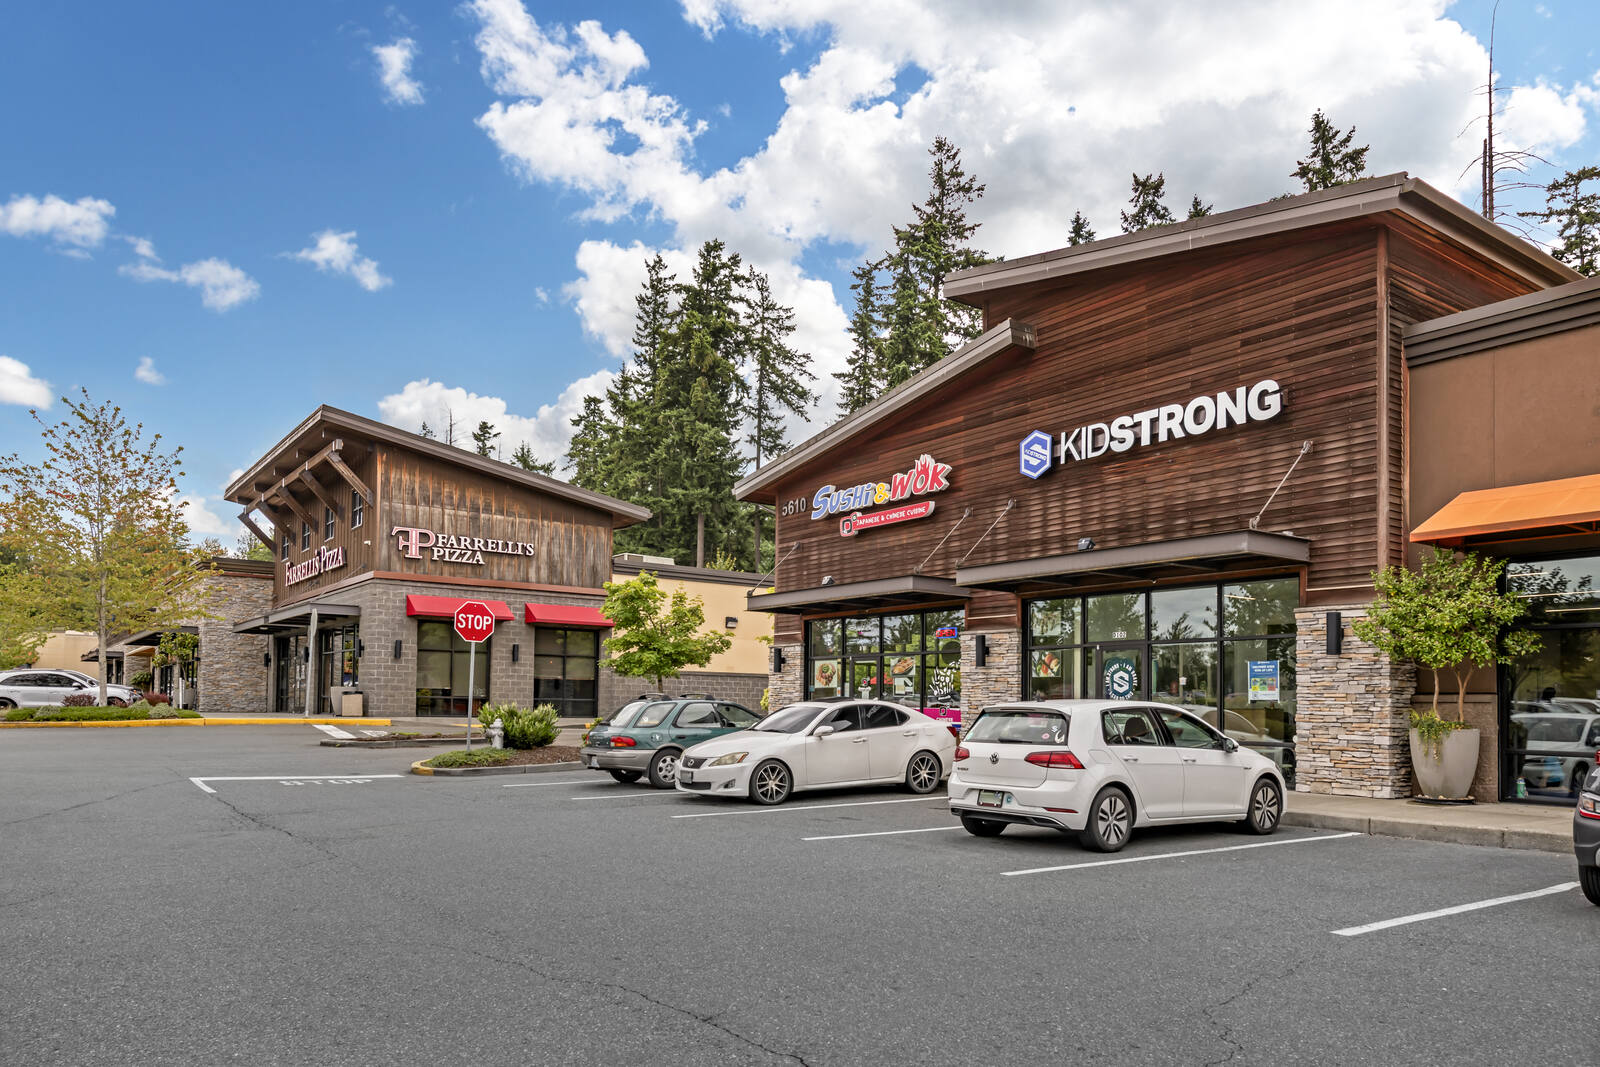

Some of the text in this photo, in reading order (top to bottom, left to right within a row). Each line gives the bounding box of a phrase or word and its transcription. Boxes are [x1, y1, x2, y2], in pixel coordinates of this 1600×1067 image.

[1060, 379, 1281, 464] KIDSTRONG
[873, 483, 889, 504] &
[890, 454, 951, 500] WOK
[856, 515, 880, 526] JAPANESE
[886, 510, 906, 520] CHINESE
[906, 506, 926, 516] CUISINE
[436, 533, 534, 556] FARRELLI'S
[285, 545, 343, 587] FARRELLI'S PIZZA
[432, 547, 485, 565] PIZZA
[457, 613, 491, 630] STOP
[935, 628, 957, 638] OPEN
